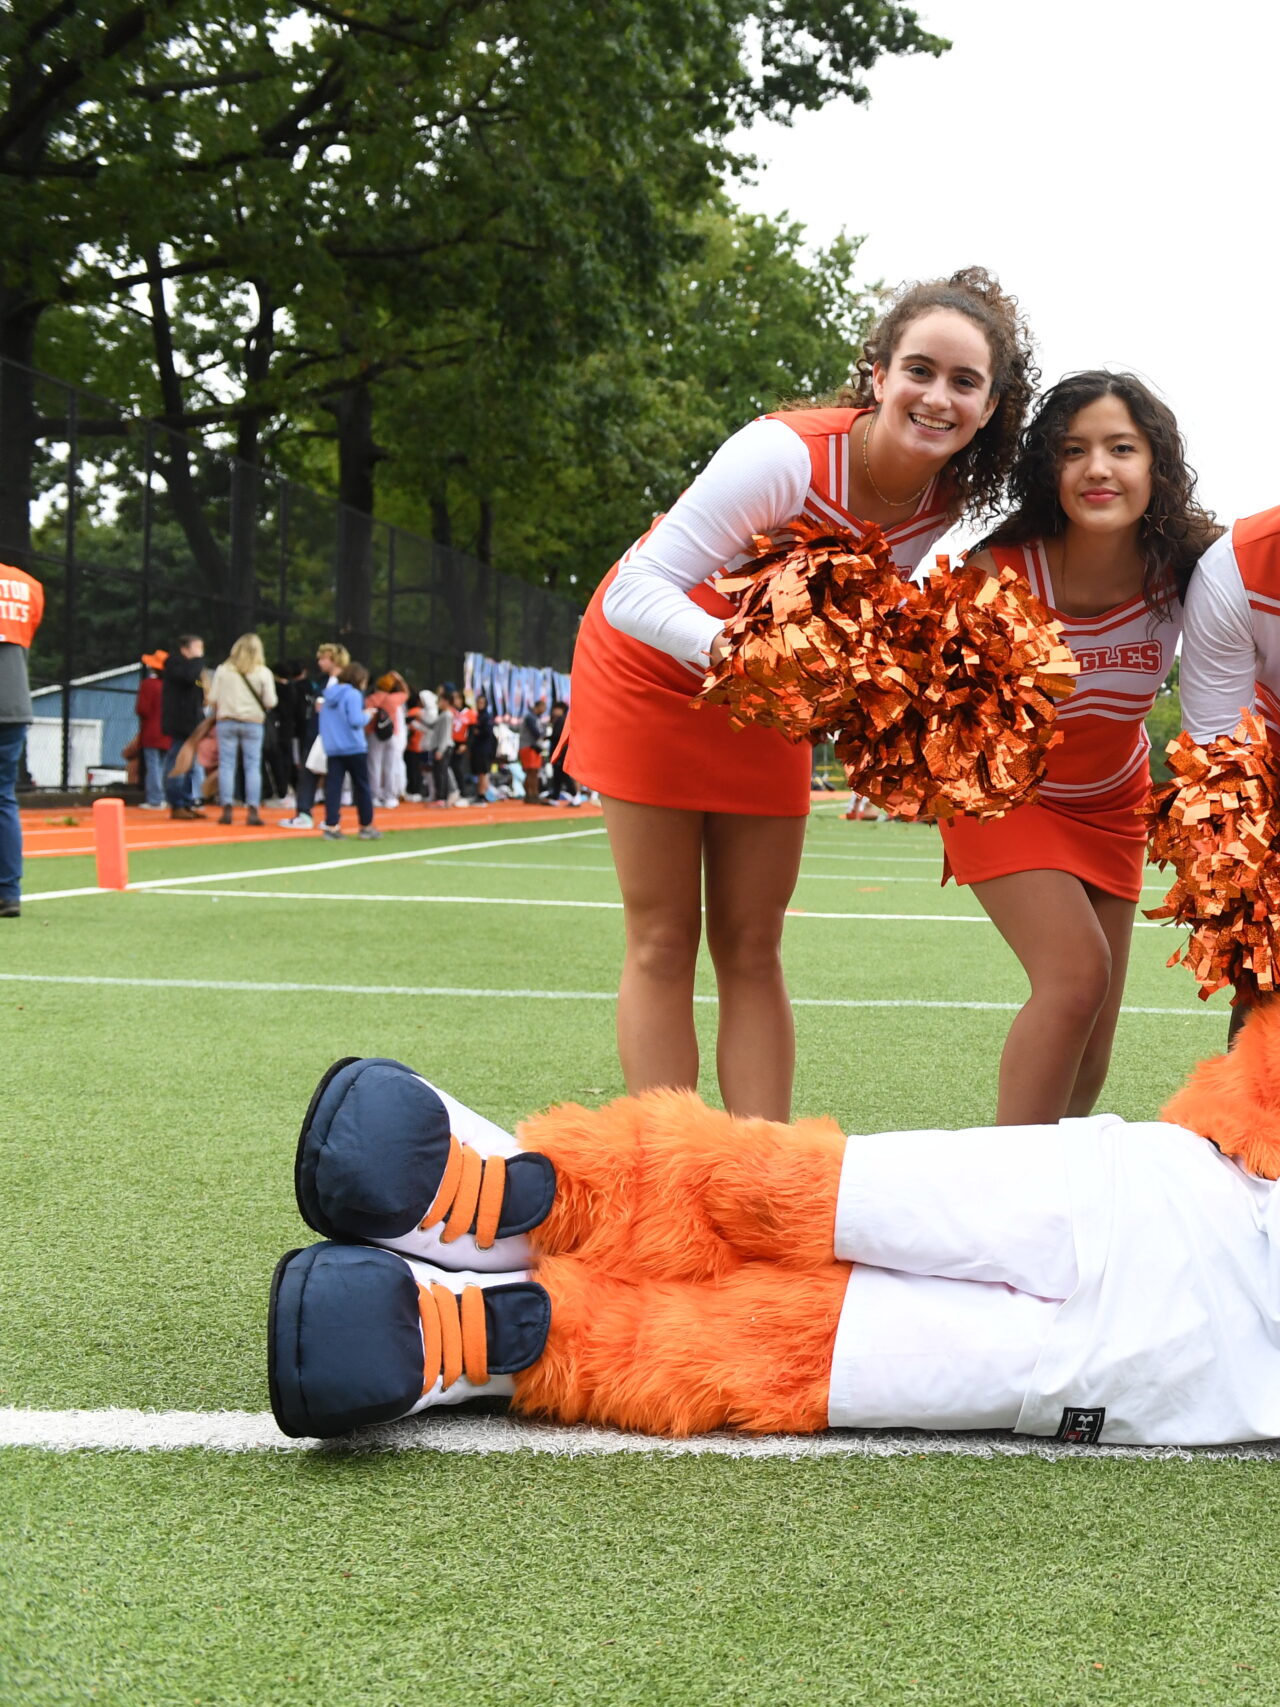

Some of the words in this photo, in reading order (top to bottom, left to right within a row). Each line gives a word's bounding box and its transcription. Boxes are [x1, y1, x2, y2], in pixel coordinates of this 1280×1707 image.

[0, 579, 29, 602] TON
[0, 600, 29, 623] TICS
[1073, 641, 1161, 673] GLES
